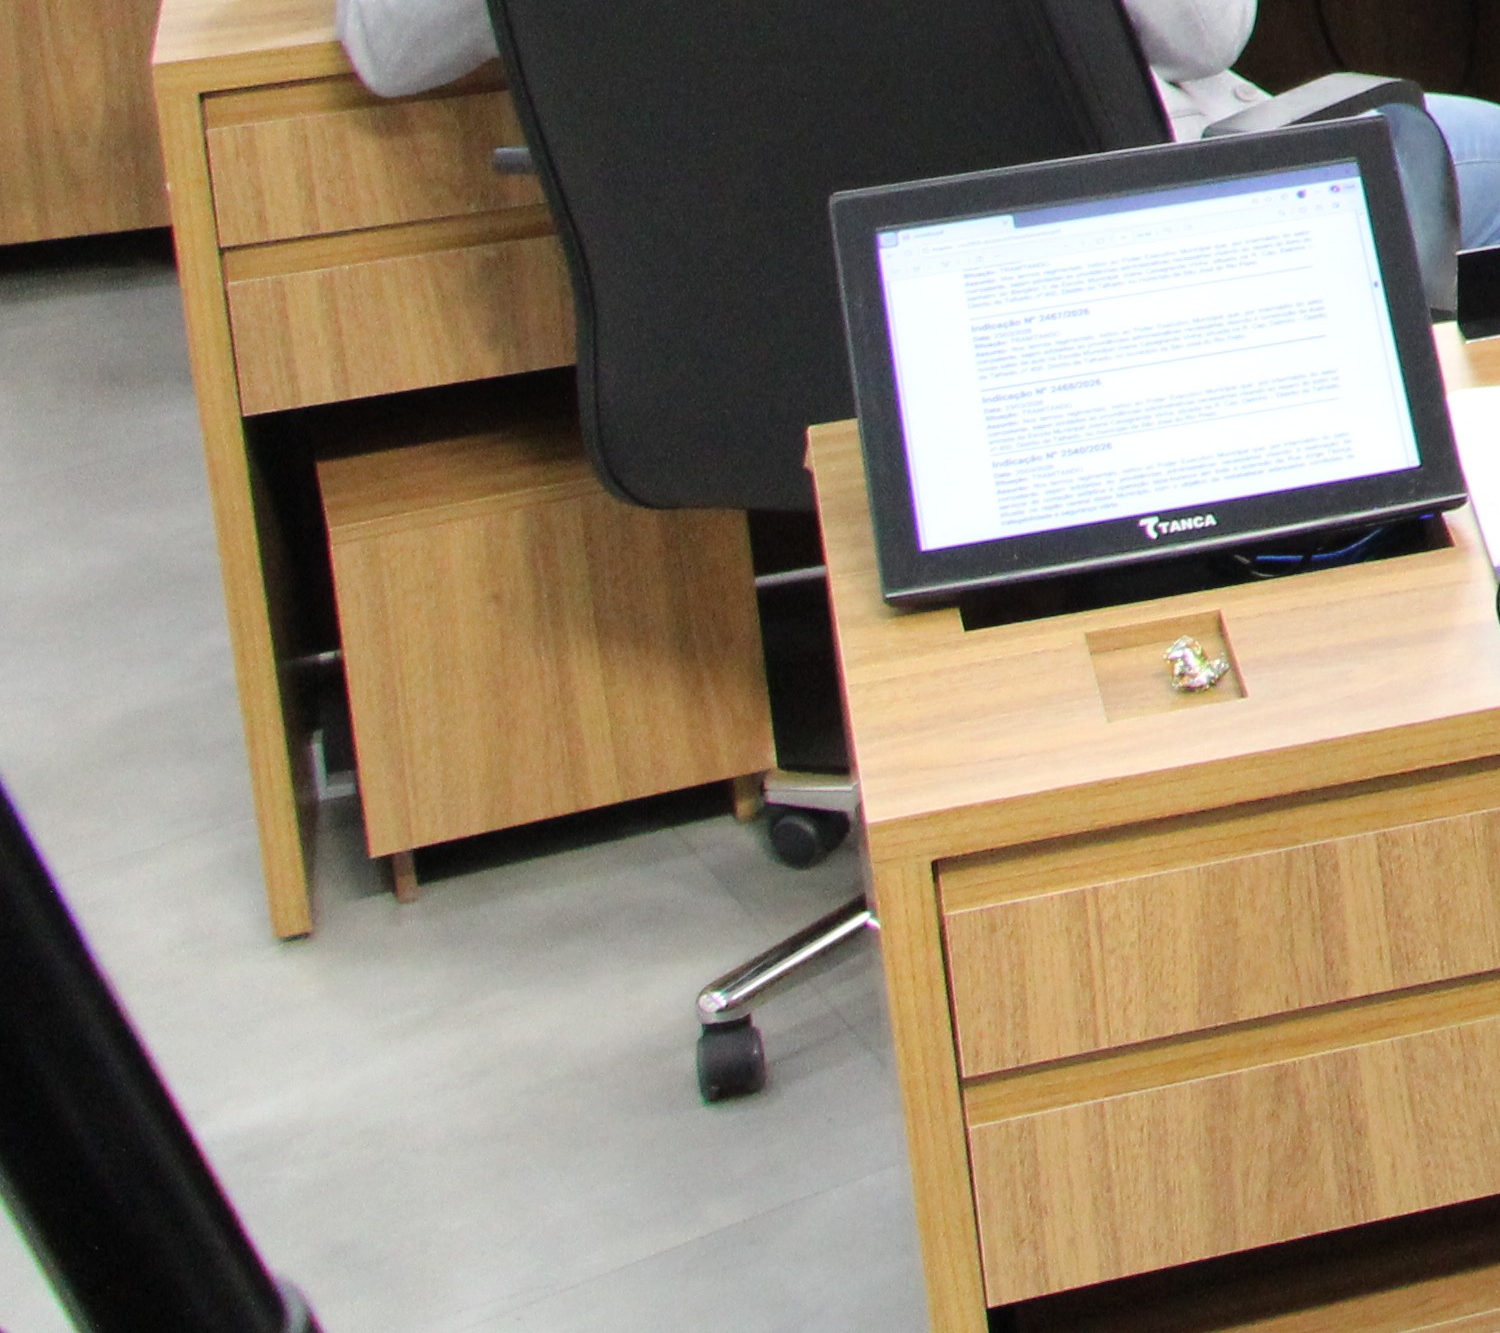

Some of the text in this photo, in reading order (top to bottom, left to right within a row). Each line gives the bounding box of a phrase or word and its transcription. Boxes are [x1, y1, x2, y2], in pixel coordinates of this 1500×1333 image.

[970, 318, 1021, 333] Indicação
[981, 389, 1032, 405] Indicação
[991, 453, 1042, 470] Indicação
[1158, 514, 1217, 534] TANCA
